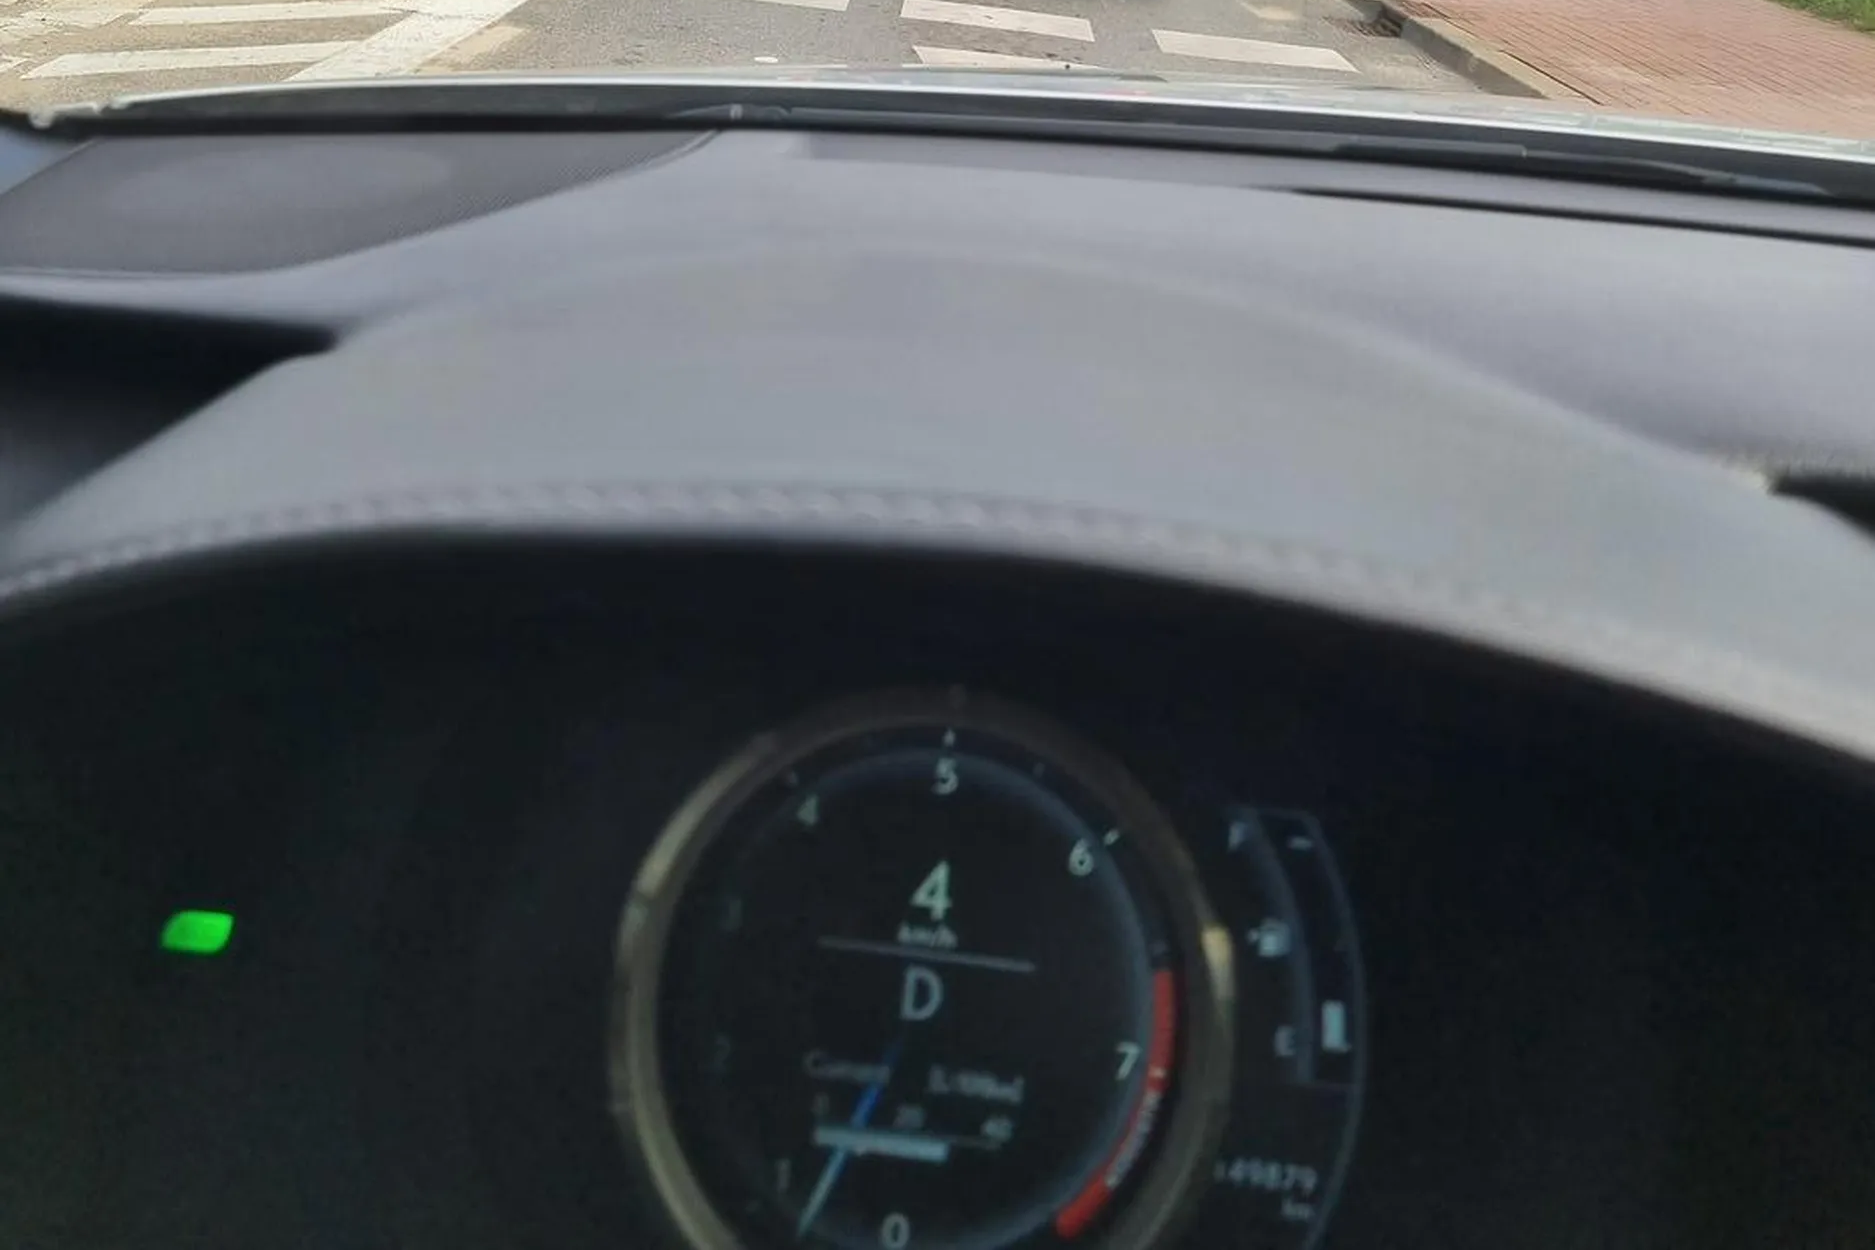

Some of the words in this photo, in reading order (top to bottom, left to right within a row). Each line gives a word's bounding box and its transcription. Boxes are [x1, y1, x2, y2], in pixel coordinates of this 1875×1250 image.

[931, 753, 960, 798] 5
[1066, 837, 1094, 878] 6
[909, 858, 954, 922] 4
[899, 965, 944, 1023] D
[1115, 1040, 1141, 1082] 7
